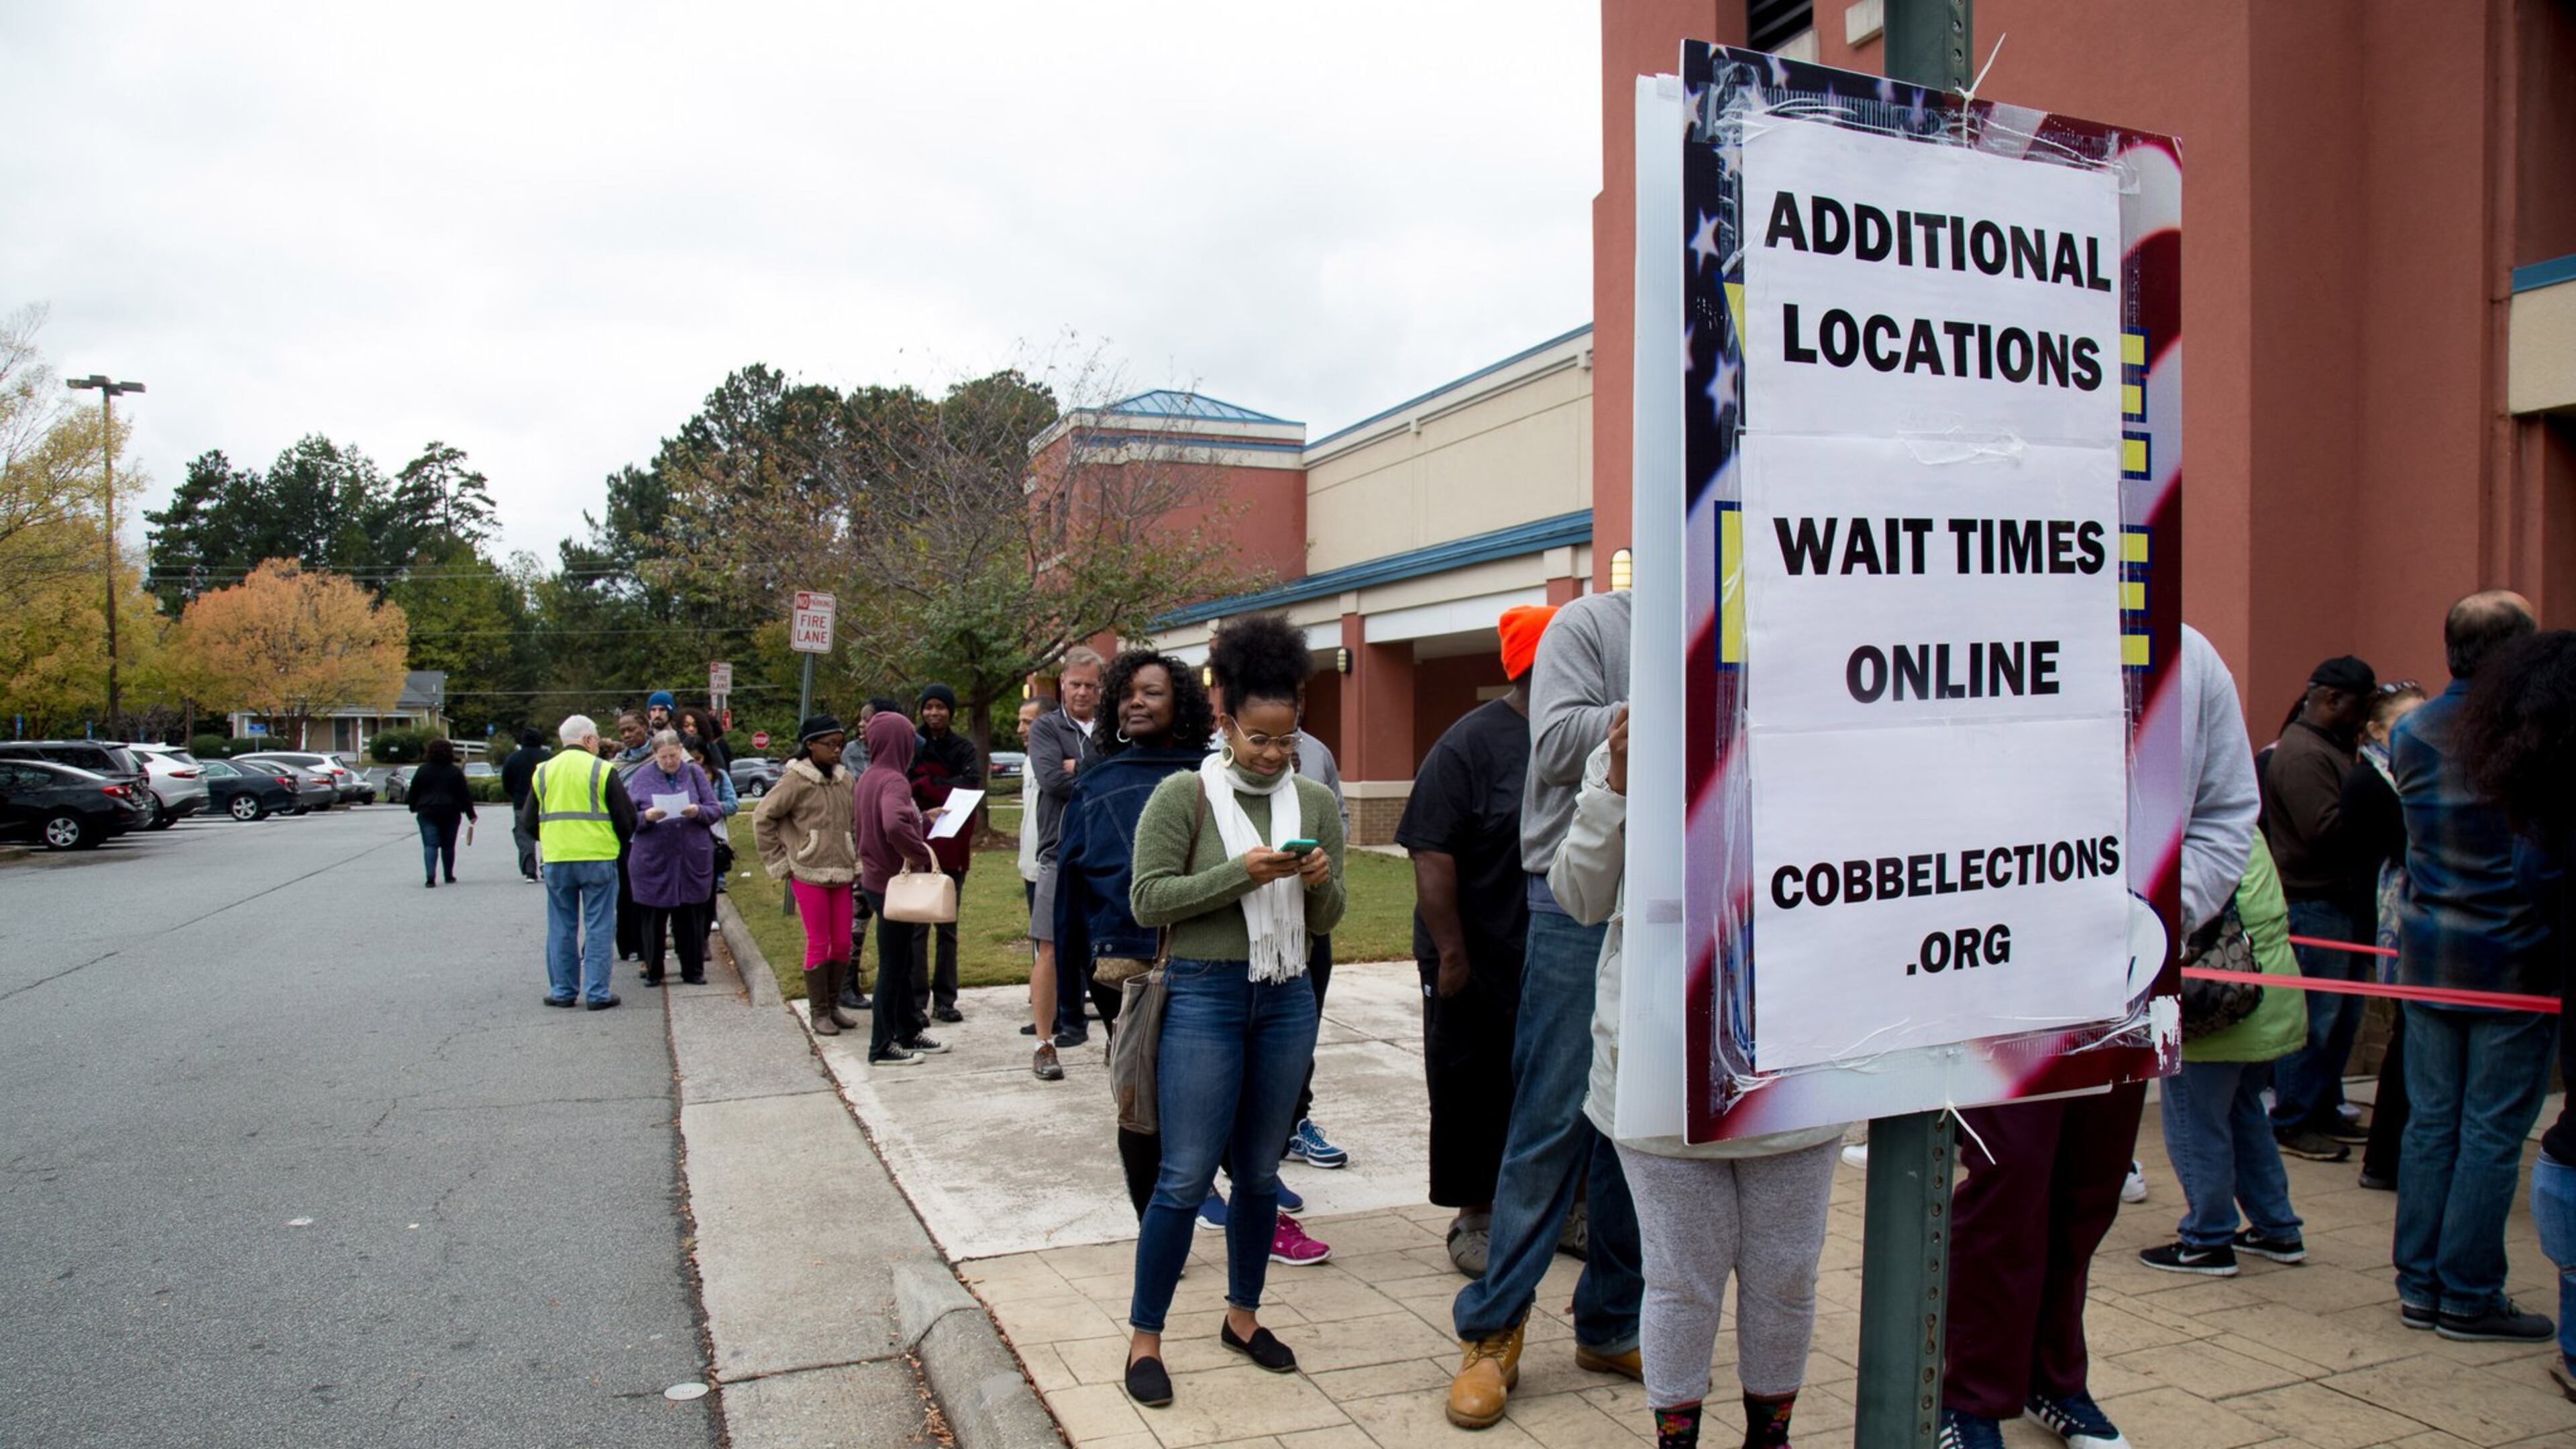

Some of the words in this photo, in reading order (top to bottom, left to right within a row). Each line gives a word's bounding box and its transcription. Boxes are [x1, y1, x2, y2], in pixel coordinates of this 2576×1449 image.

[1766, 191, 2111, 292] ADDITIONAL
[1784, 304, 2102, 392] LOCATIONS
[1773, 518, 1933, 575] WAIT
[1949, 519, 2105, 575] TIMES
[797, 596, 808, 608] NO
[800, 614, 826, 629] FIRE
[797, 629, 828, 644] LANE
[1847, 641, 2059, 703] ONLINE
[1771, 835, 2120, 910] COBBELECTIONS
[1907, 924, 2010, 975] .ORG
